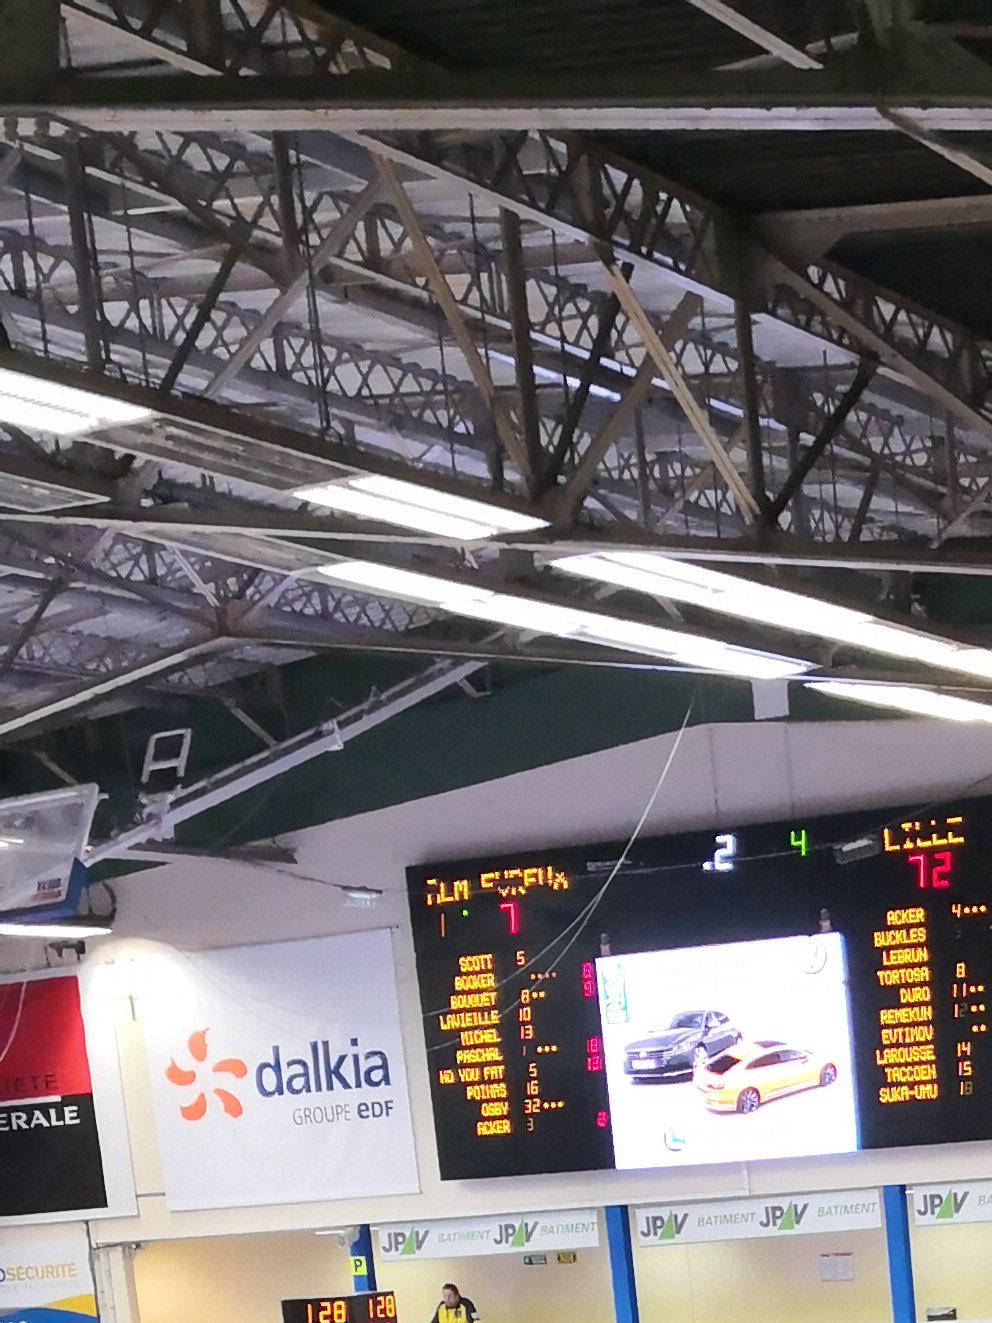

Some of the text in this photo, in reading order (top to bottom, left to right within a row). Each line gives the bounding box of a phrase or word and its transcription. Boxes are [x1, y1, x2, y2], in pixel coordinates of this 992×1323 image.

[790, 829, 807, 857] 4
[907, 851, 953, 889] 72
[499, 900, 519, 935] 7
[886, 907, 925, 926] ACKER
[873, 927, 927, 947] BUCKLES
[458, 954, 493, 972] SCOTT
[882, 946, 929, 966] LEBRUN
[454, 973, 496, 991] BOOKER
[876, 966, 930, 986] TORTOSA
[899, 987, 931, 1004] DURO
[255, 1037, 392, 1098] dalkia
[292, 1102, 352, 1126] GROUPE
[698, 1212, 755, 1227] BATIMENT
[817, 1202, 877, 1217] BATIMENT
[438, 1230, 491, 1243] BATIMENT
[541, 1222, 597, 1236] BATIMENT
[354, 1259, 364, 1274] P
